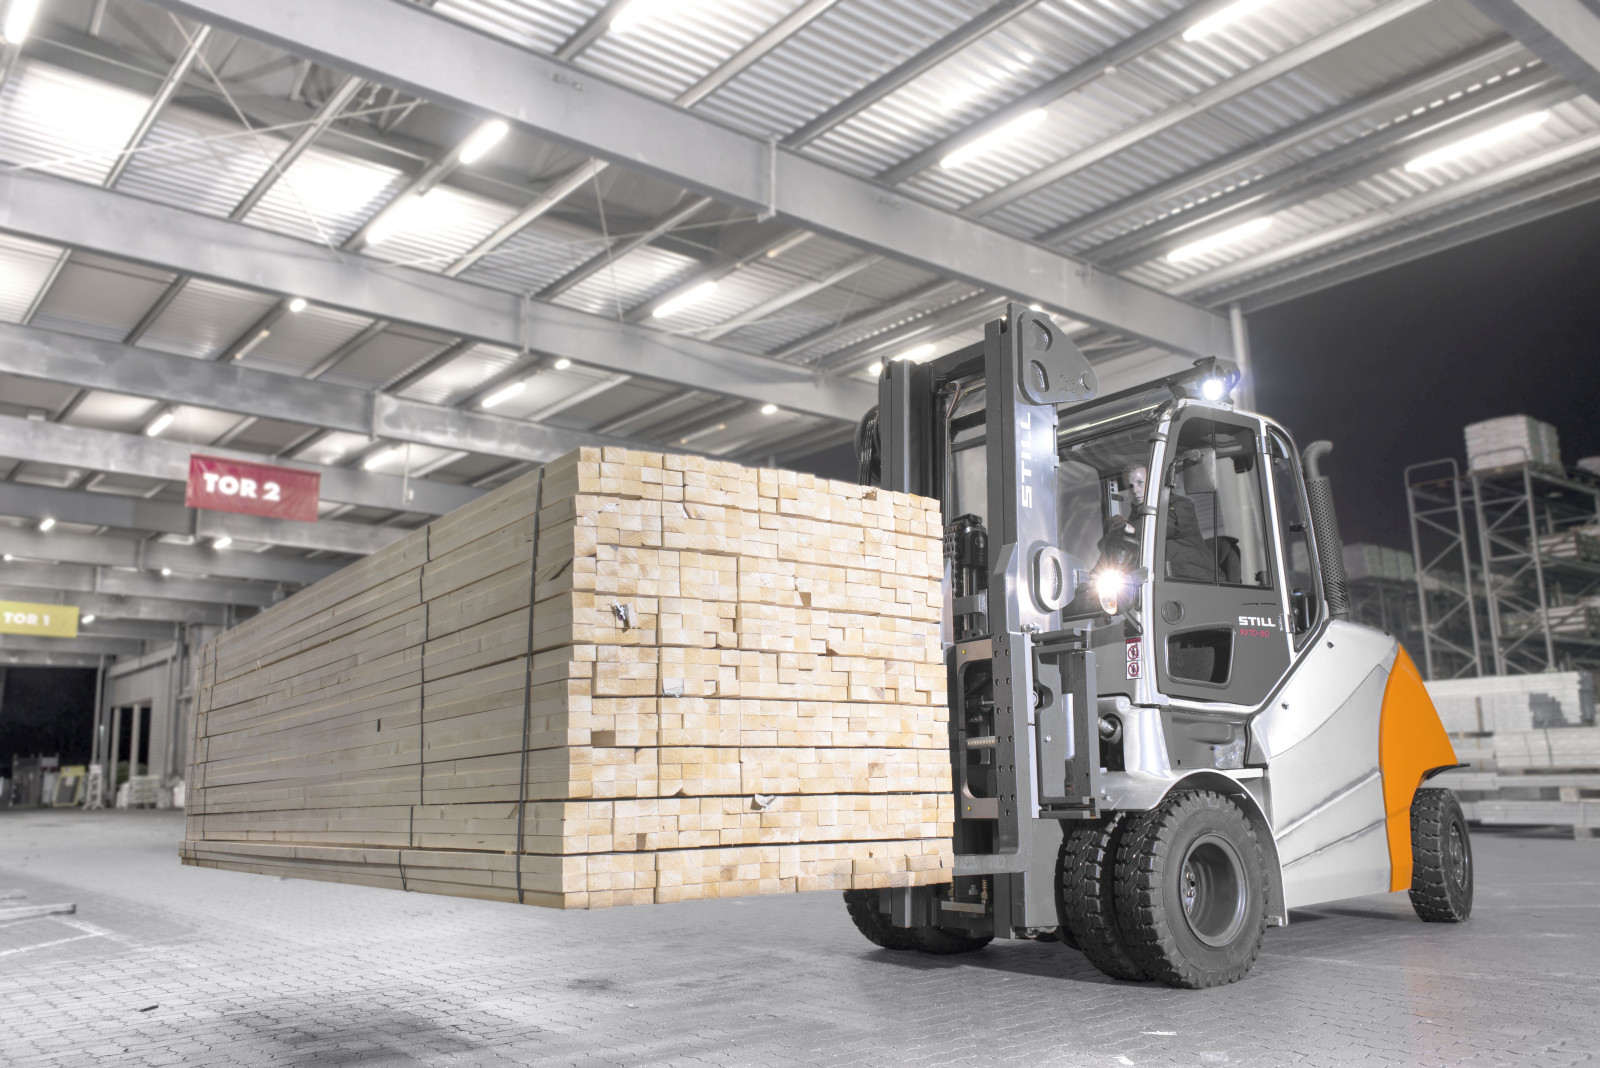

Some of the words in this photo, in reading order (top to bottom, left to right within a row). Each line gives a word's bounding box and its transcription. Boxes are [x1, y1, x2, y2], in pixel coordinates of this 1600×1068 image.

[1020, 412, 1032, 508] STILL
[203, 473, 257, 499] TOR
[262, 481, 281, 502] 2
[4, 612, 38, 625] TOR
[43, 614, 50, 626] 1
[1238, 616, 1276, 627] STILL
